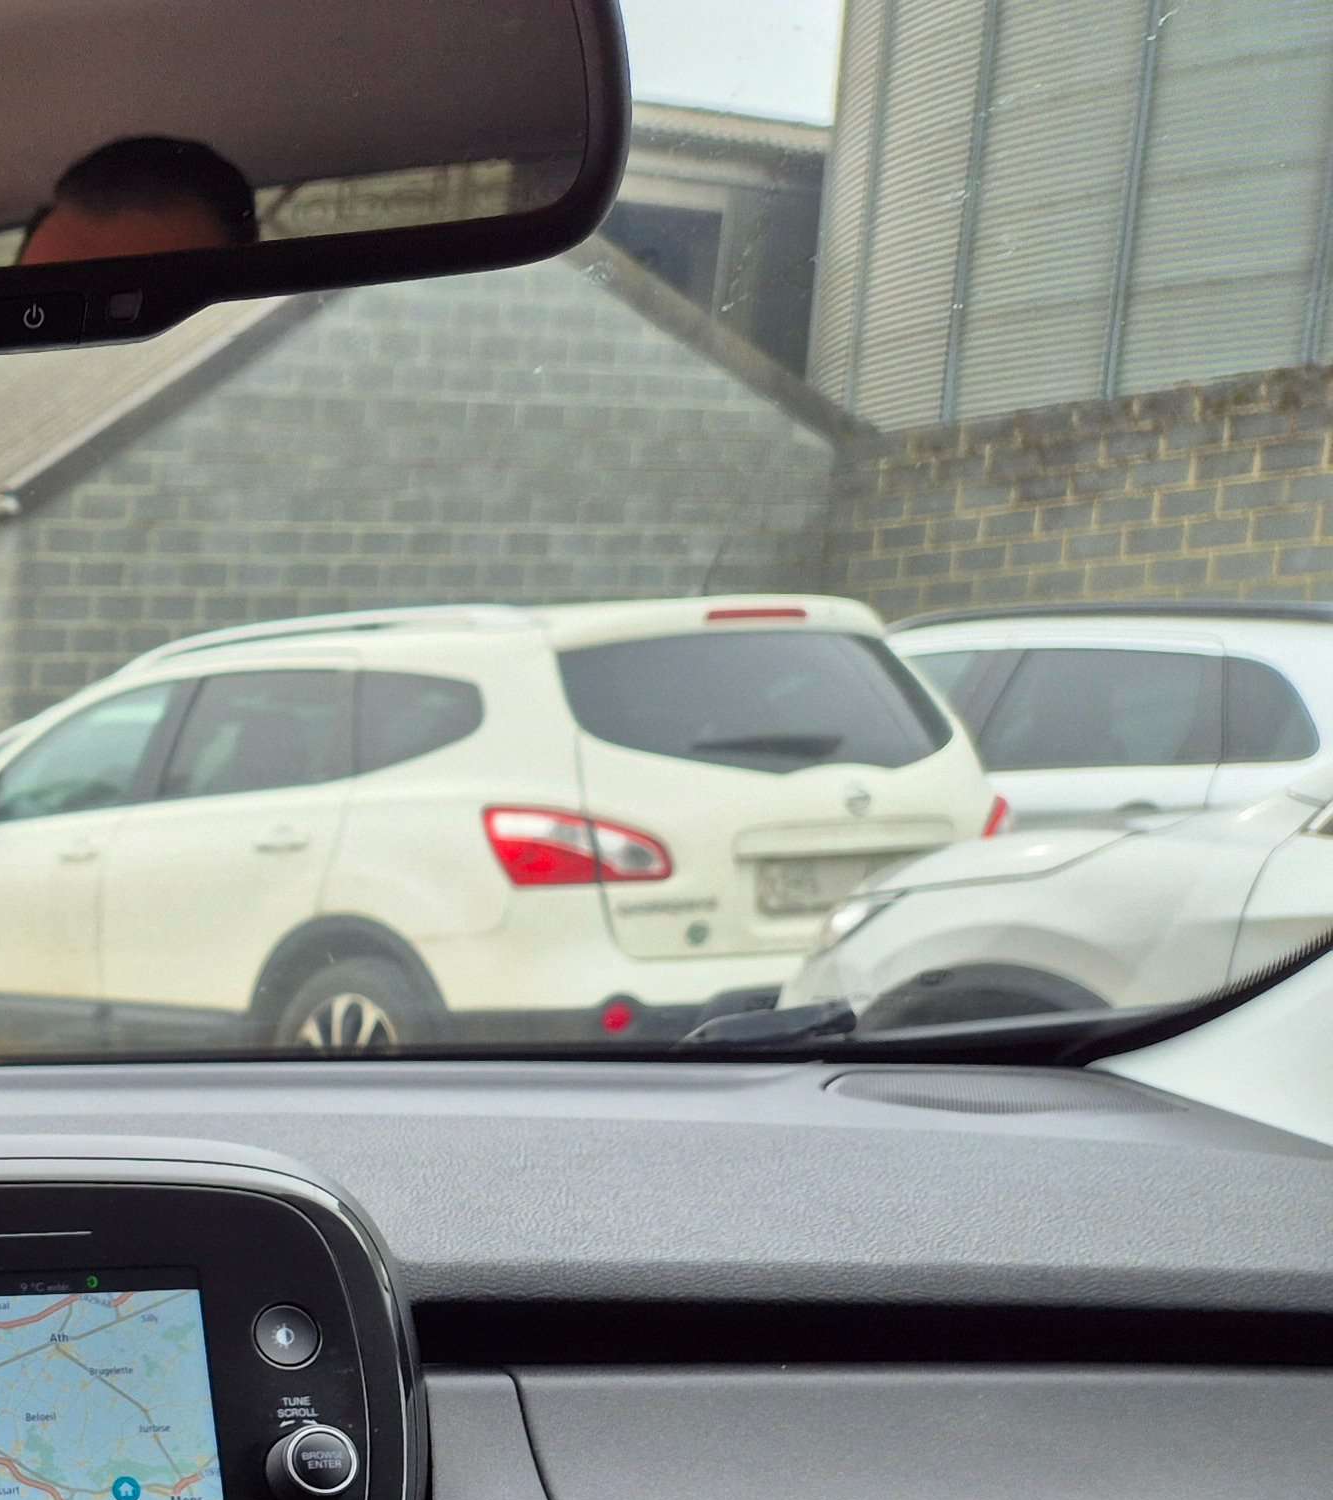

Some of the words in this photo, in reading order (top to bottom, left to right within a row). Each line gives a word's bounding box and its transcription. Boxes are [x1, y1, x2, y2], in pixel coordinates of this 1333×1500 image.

[49, 1332, 69, 1343] Ath
[282, 1396, 312, 1407] TUNE
[277, 1407, 319, 1418] SCROLL
[301, 1451, 343, 1462] BROWSE
[307, 1460, 342, 1470] ENTER
